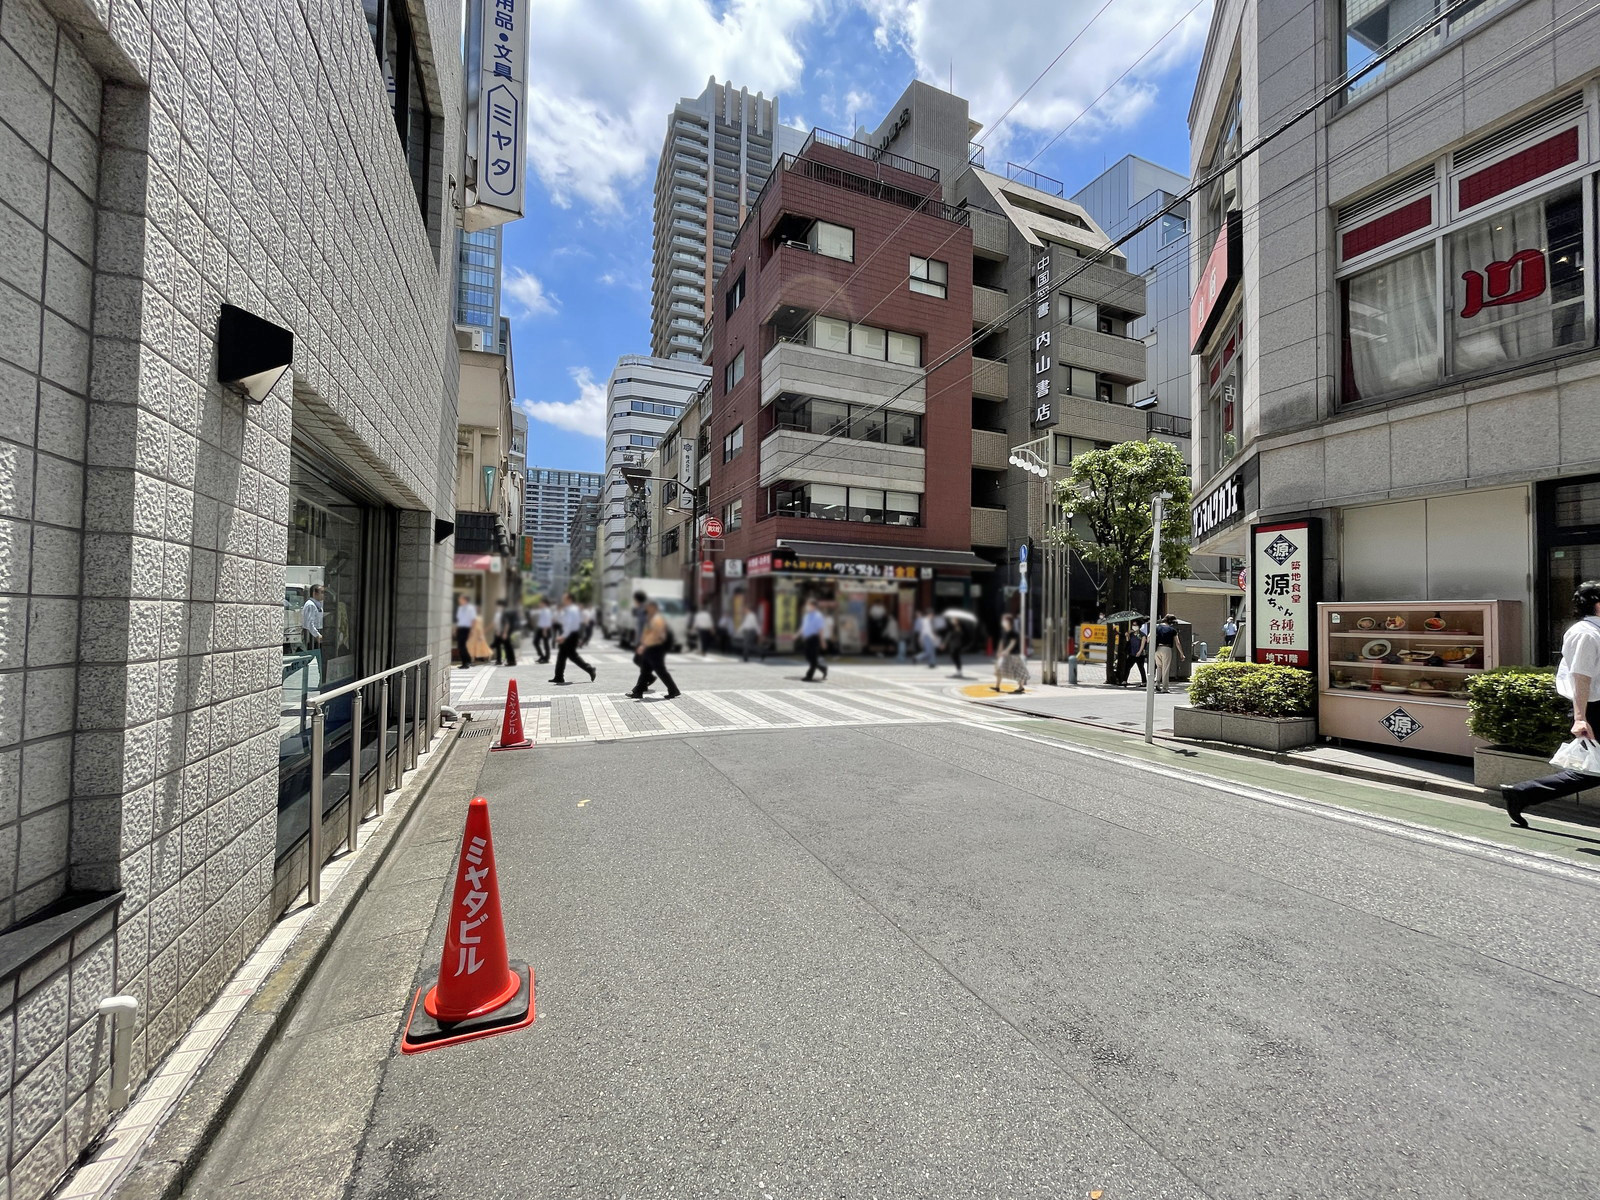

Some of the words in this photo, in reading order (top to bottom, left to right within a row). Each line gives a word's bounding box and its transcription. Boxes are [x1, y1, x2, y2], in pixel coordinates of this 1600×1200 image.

[491, 103, 512, 176] ミヤタ
[1035, 331, 1051, 422] 内山書店
[1193, 479, 1238, 538] サンマルクカフェ
[1291, 561, 1301, 603] 築地食堂
[1269, 619, 1294, 631] 各種
[1269, 633, 1295, 645] 海鮮
[1266, 652, 1298, 664] 地下1階
[508, 690, 518, 735] ミヤタビル
[454, 836, 489, 977] ミヤタビル
